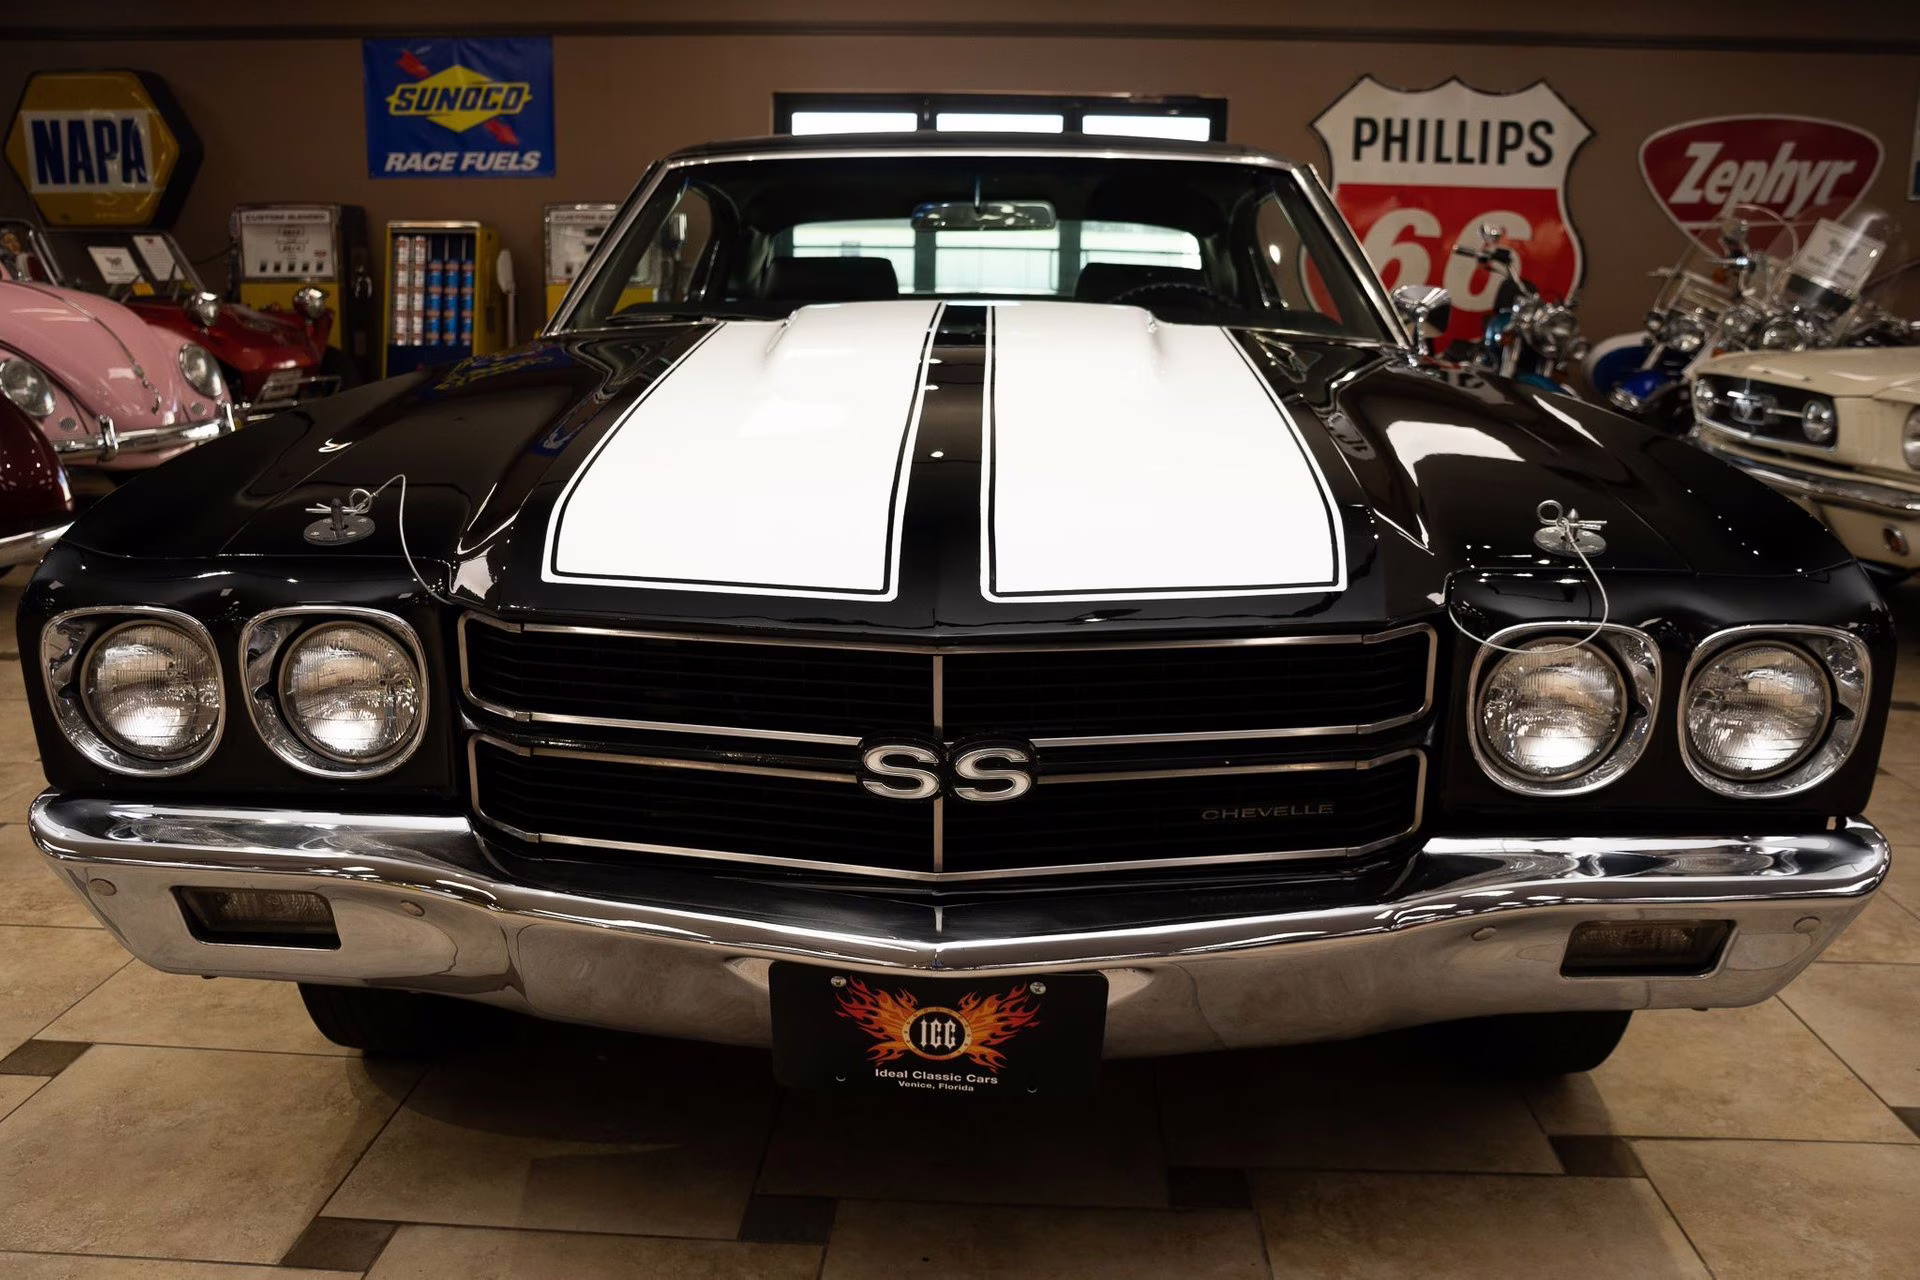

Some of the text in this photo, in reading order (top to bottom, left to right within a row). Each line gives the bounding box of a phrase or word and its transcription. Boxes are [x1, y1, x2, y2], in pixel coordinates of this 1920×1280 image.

[394, 86, 526, 112] SUNOCO
[31, 118, 148, 185] NAPA
[1352, 117, 1555, 168] PHILLIPS
[384, 150, 542, 173] RACE FUELS
[1667, 140, 1858, 219] Zephyr
[1362, 207, 1533, 312] 66
[862, 744, 1033, 802] SS
[1201, 803, 1335, 821] CHEVELLE
[920, 1017, 956, 1050] ICC
[875, 1068, 998, 1085] Ideal Classic Cars
[898, 1080, 974, 1092] Venice, Florida
